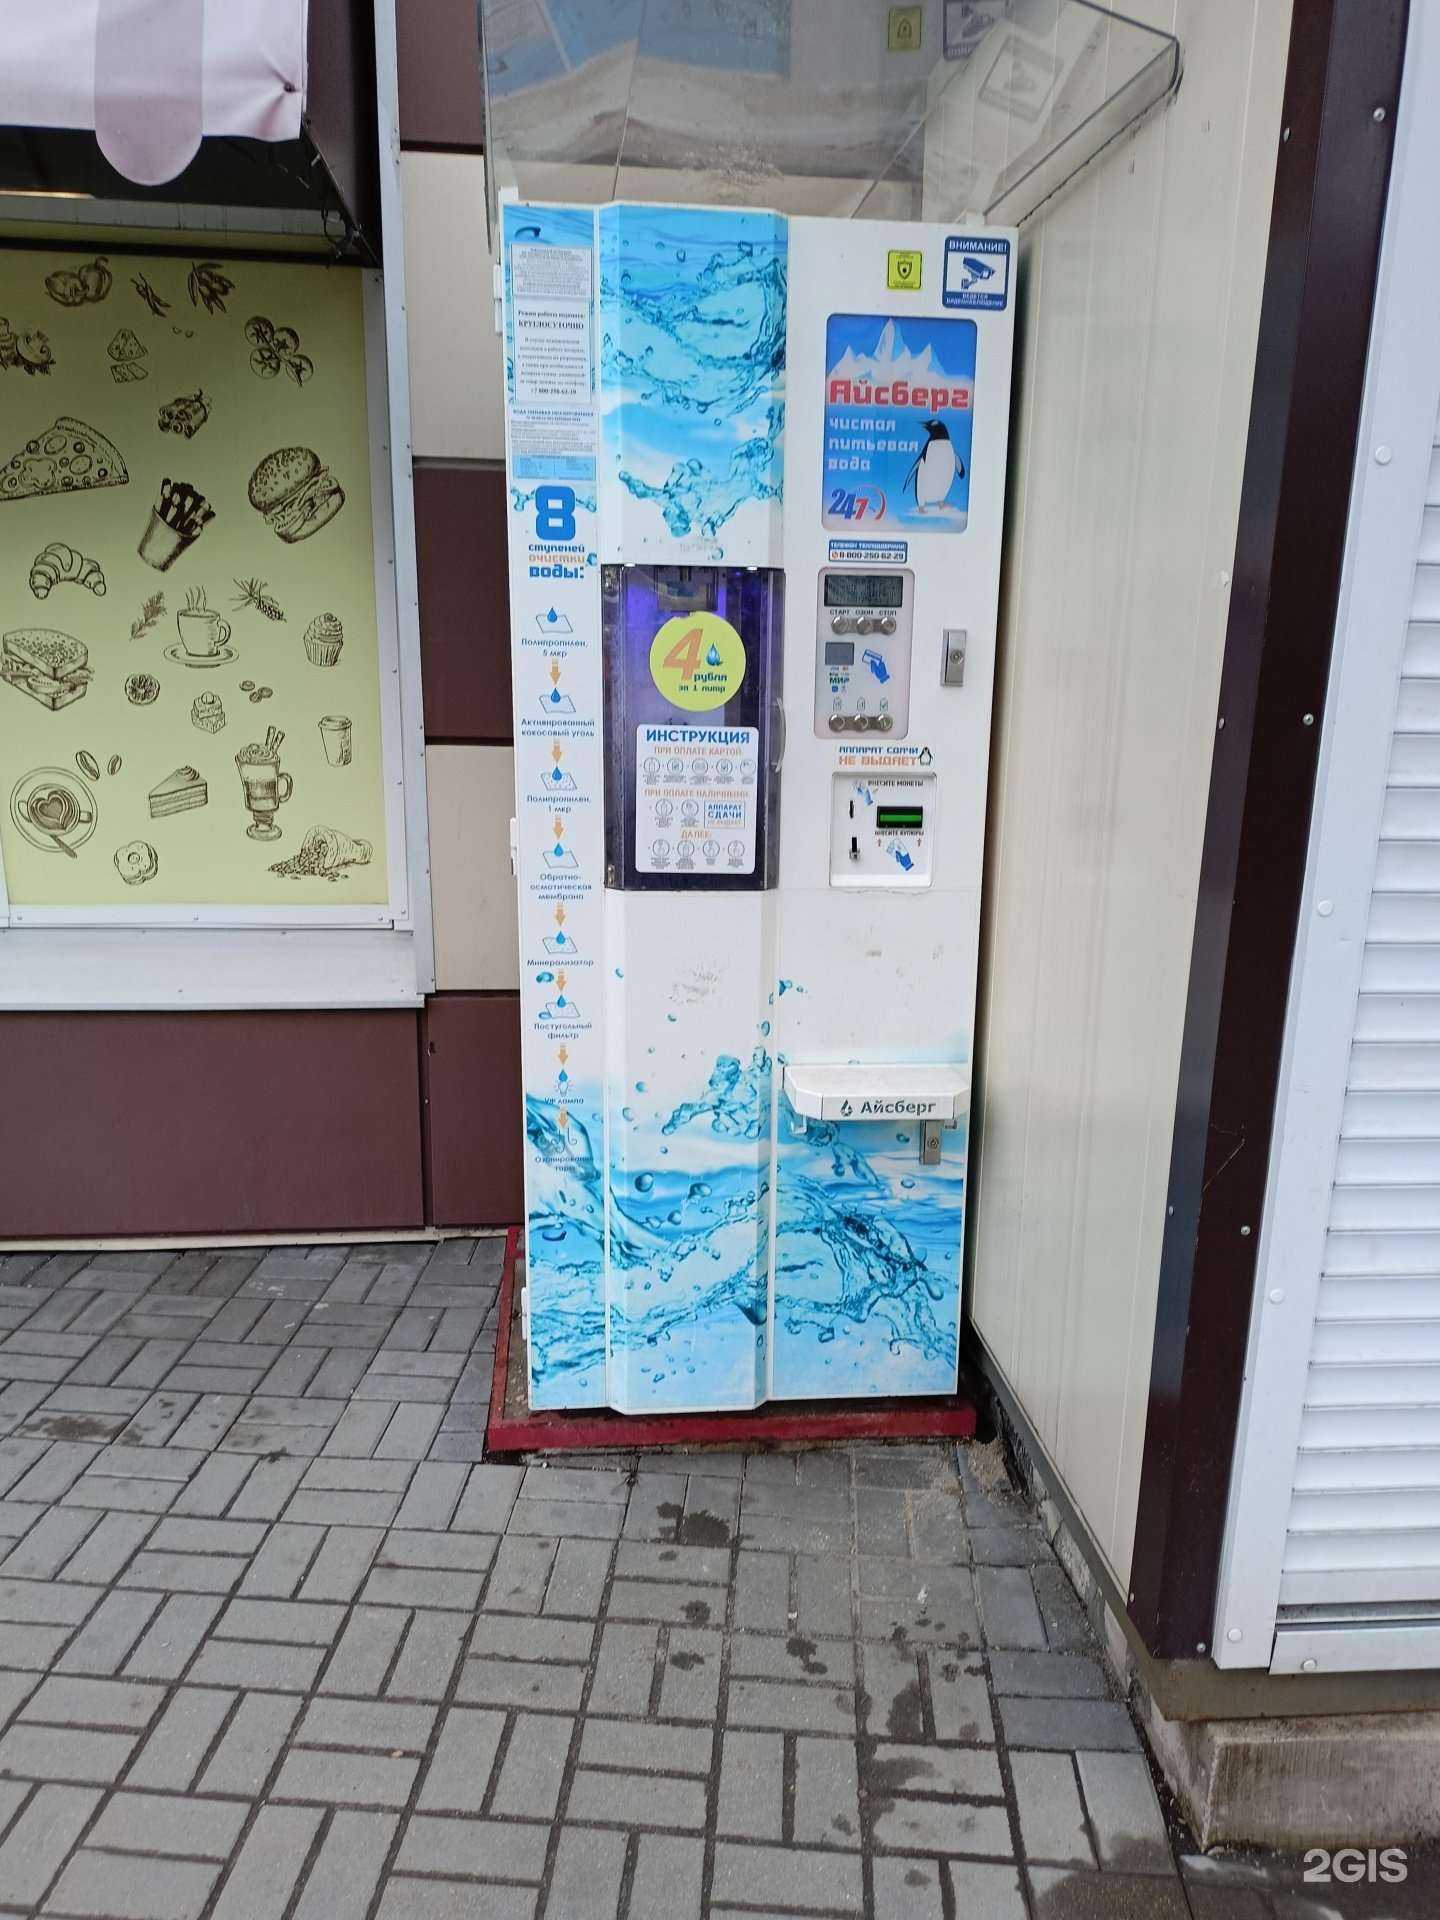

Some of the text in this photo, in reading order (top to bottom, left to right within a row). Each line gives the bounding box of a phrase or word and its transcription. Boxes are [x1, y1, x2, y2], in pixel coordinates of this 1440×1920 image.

[949, 239, 1007, 252] ВНИМАНИЕ!
[518, 319, 584, 329] КРУГЛОСУТОЧНО
[829, 380, 969, 412] Айсберг
[829, 416, 896, 431] чистая
[829, 438, 919, 453] питьевая
[828, 456, 871, 471] вода
[535, 486, 576, 540] 8
[528, 544, 585, 553] ступеней
[528, 554, 585, 563] очистки
[529, 564, 584, 579] воды:
[662, 628, 704, 681] 4
[694, 672, 727, 683] рубля
[829, 676, 850, 684] МИР
[679, 684, 689, 692] за
[701, 685, 726, 693] литр
[521, 719, 596, 727] Активированный
[521, 729, 570, 737] кокосовый
[646, 730, 750, 745] ИНСТРУКЦИЯ
[654, 746, 672, 755] ПРИ
[674, 747, 705, 756] ОПЛАТЕ
[839, 746, 884, 754] АППАРАТ
[839, 755, 918, 767] НЕ ВЫДАЕТ
[644, 788, 661, 797] ПРИ
[663, 789, 694, 798] ОПЛАТЕ
[707, 803, 742, 811] АППАРАТ
[707, 810, 742, 819] СДАЧИ
[538, 893, 585, 902] мембрана
[526, 959, 594, 968] Минерализатор
[534, 1023, 593, 1032] Постугольный
[547, 1032, 580, 1041] фильтр
[860, 1100, 938, 1116] Айсберг
